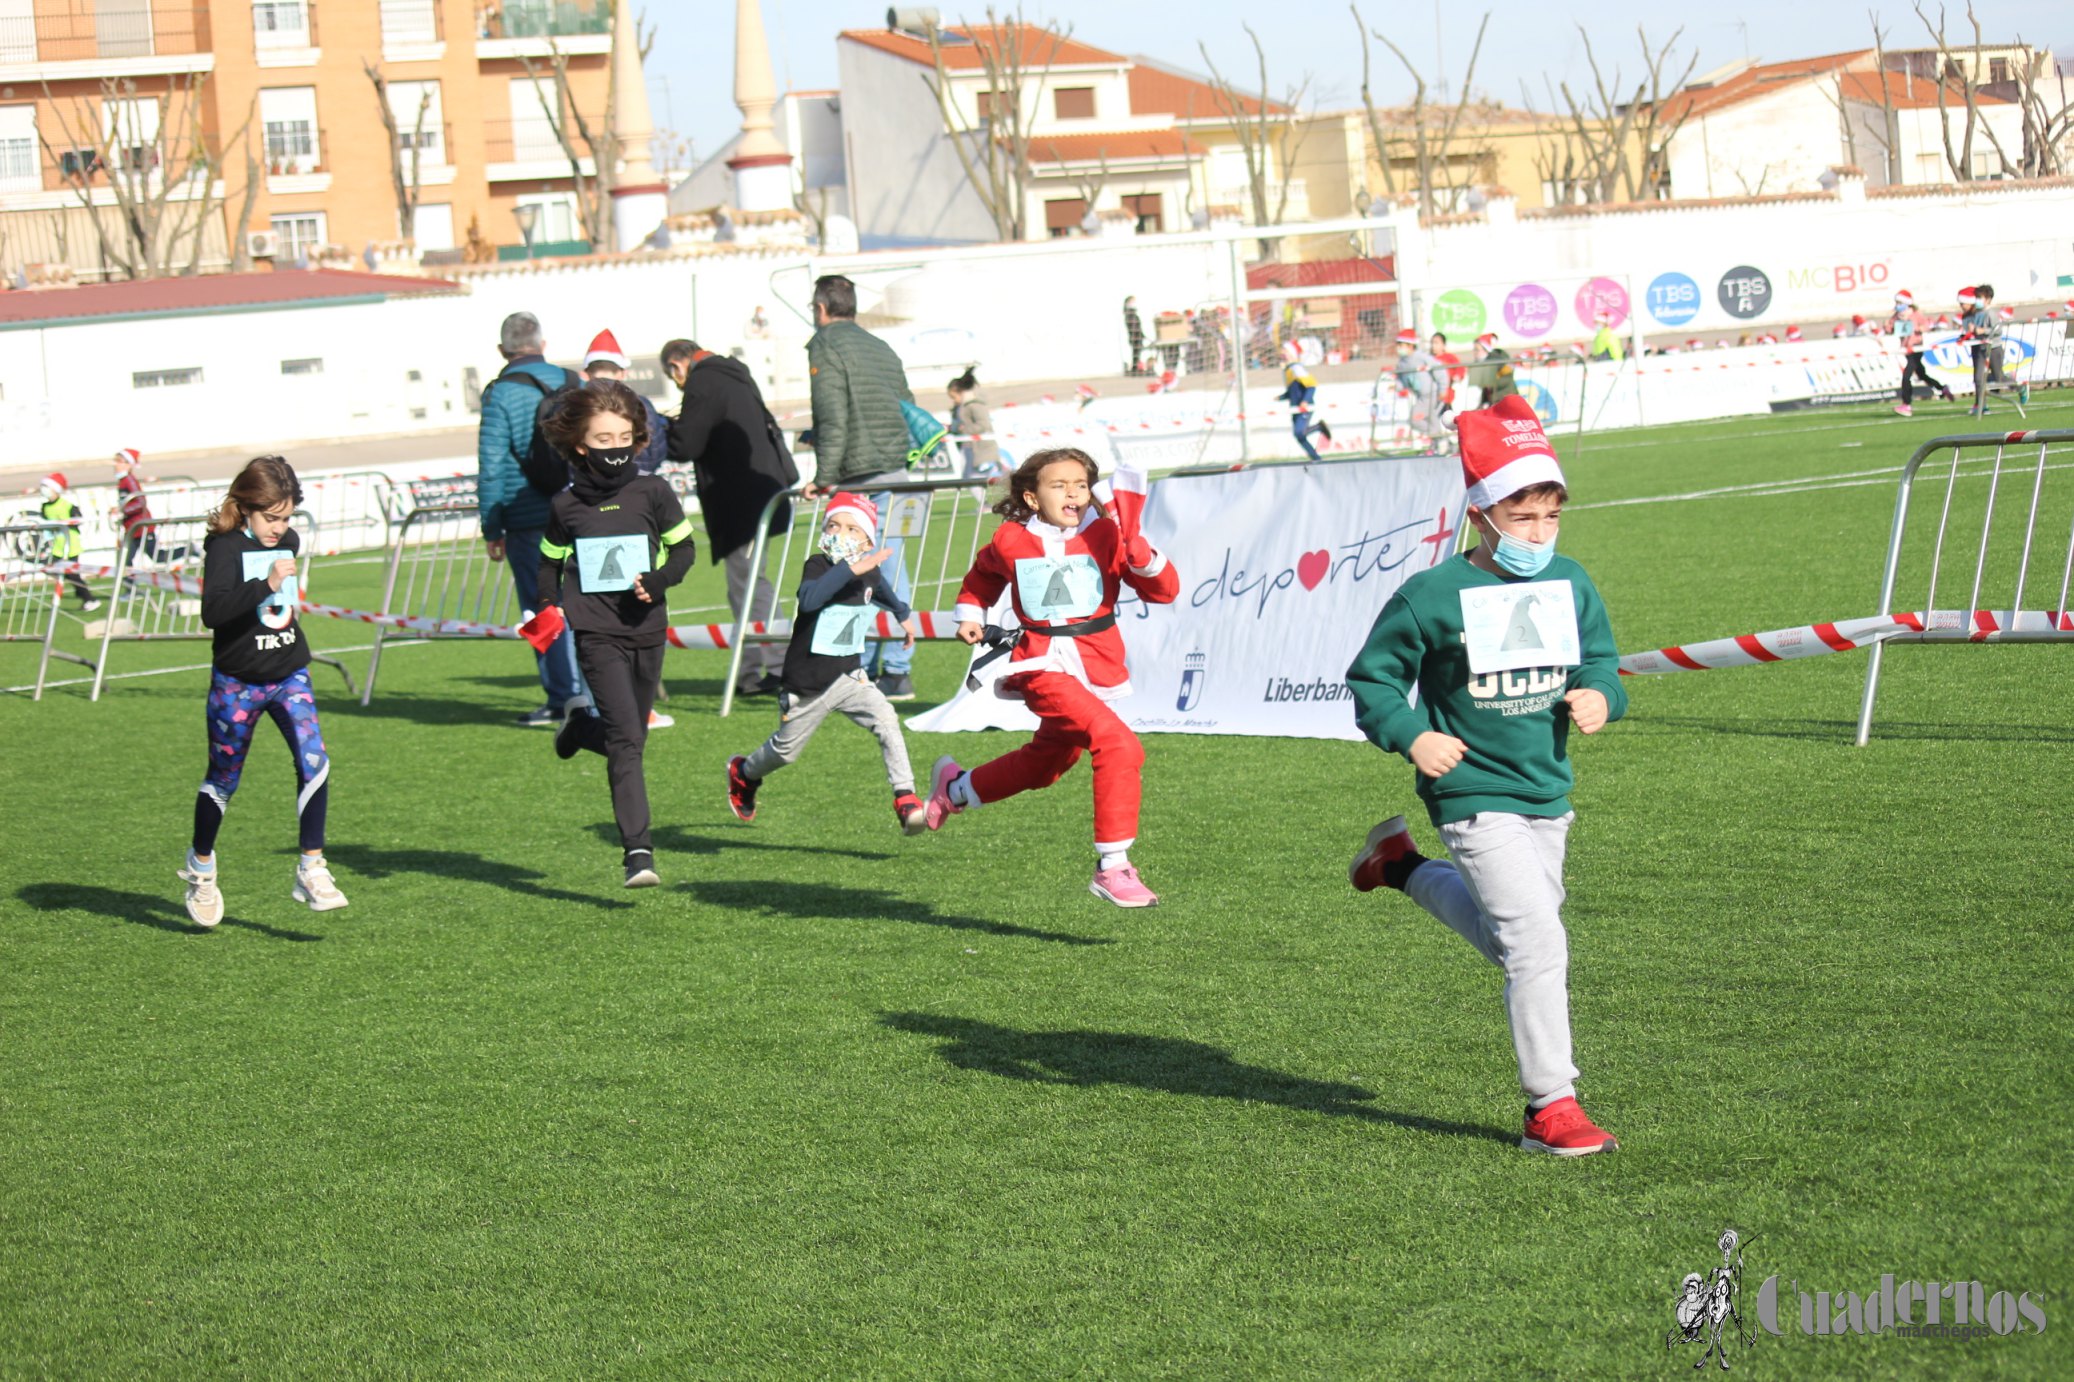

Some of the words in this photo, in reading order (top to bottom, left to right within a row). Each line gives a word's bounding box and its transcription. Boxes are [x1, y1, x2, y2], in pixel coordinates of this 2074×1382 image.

[1651, 283, 1695, 305] TBS
[1722, 276, 1767, 299] TBS
[1434, 301, 1480, 322] TBS
[1509, 296, 1551, 317] TBS
[1052, 587, 1061, 601] 7
[1514, 624, 1529, 642] 2
[1263, 677, 1356, 704] Liberban
[1474, 699, 1525, 709] UNIVERSITY
[1525, 697, 1536, 707] OF
[1502, 707, 1519, 717] LOS
[1519, 701, 1552, 716] ANGELES
